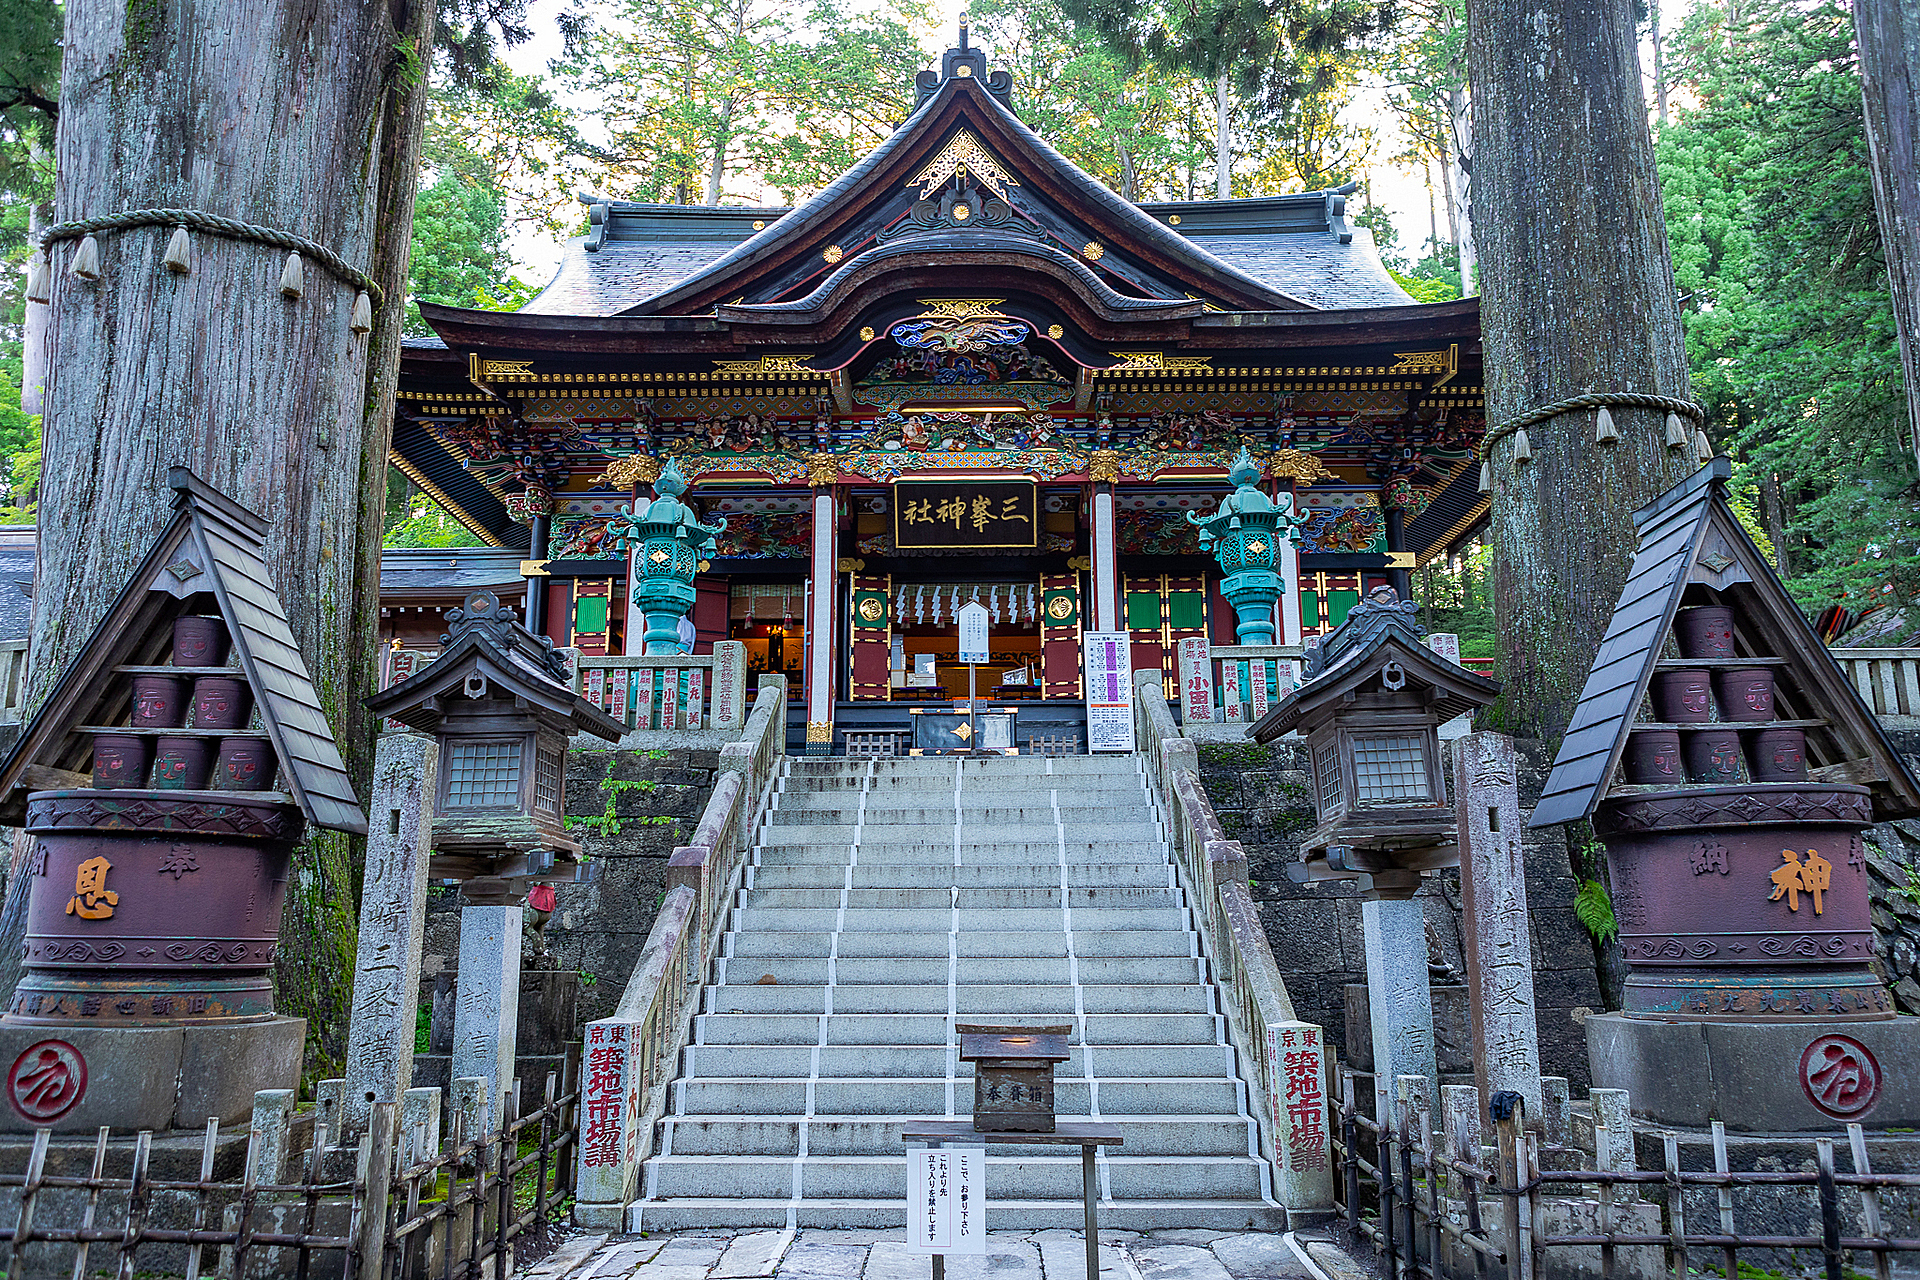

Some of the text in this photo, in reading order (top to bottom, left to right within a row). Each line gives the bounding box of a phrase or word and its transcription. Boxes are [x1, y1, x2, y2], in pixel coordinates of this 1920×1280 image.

[903, 494, 1029, 533] 三峯神社
[1690, 840, 1730, 875] 納
[1767, 849, 1832, 915] 神
[589, 1026, 626, 1044] 東京
[1281, 1030, 1319, 1048] 東京
[584, 1046, 625, 1168] 築地市場講
[1284, 1050, 1328, 1173] 築地市場講
[927, 1154, 937, 1242] 立ち入りを禁止します
[939, 1154, 948, 1197] これより先
[960, 1155, 970, 1237] ここで、お参り下さい
